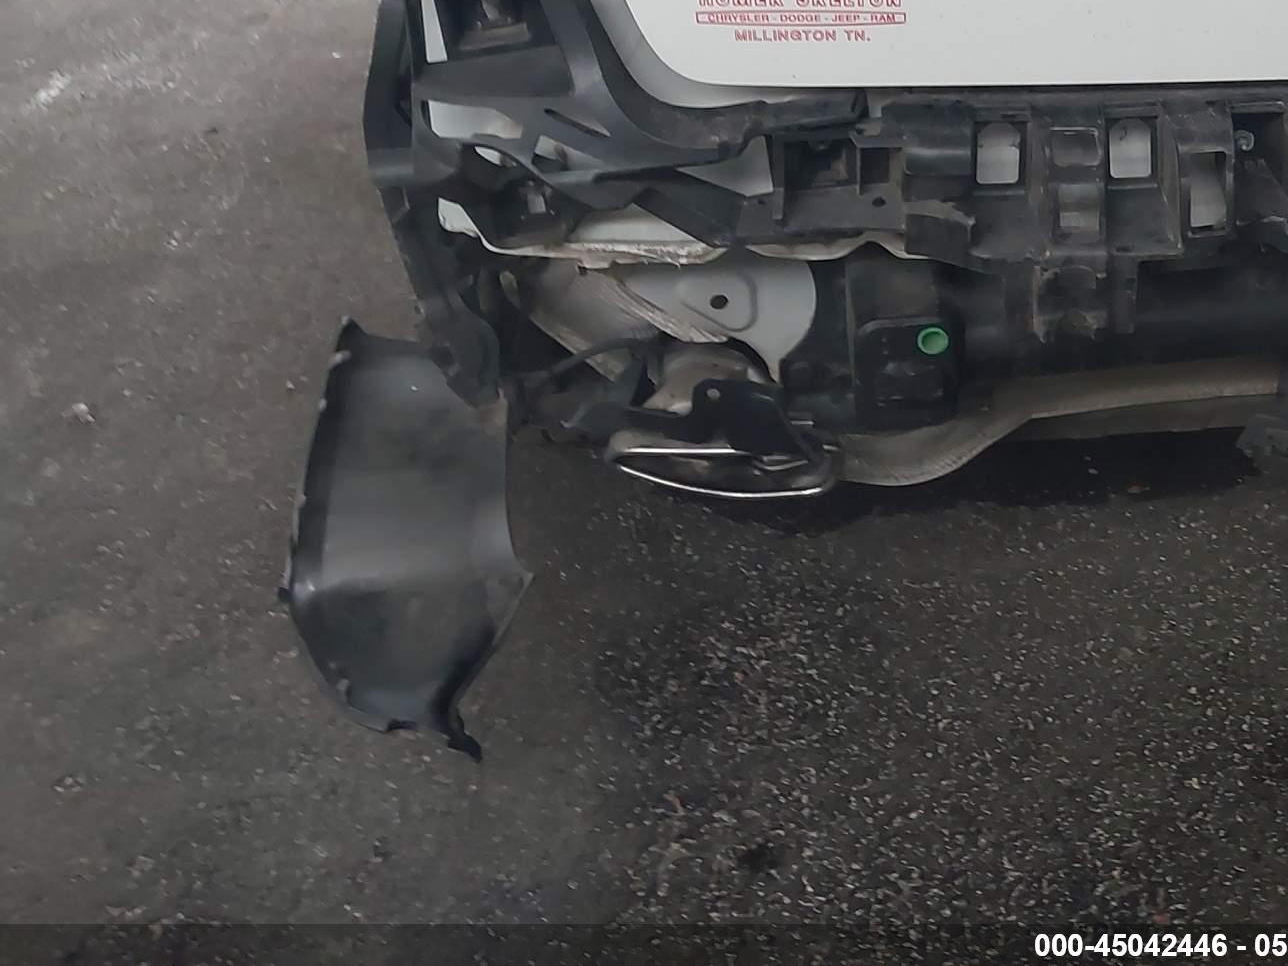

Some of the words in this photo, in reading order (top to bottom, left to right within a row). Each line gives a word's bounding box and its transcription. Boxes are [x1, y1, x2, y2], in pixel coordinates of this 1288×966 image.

[707, 13, 770, 24] CHRYSLER
[779, 13, 822, 24] DODGE
[831, 13, 861, 23] JEEP
[870, 13, 896, 23] RAM
[734, 29, 837, 42] MILLINGTON
[844, 29, 871, 42] TN.
